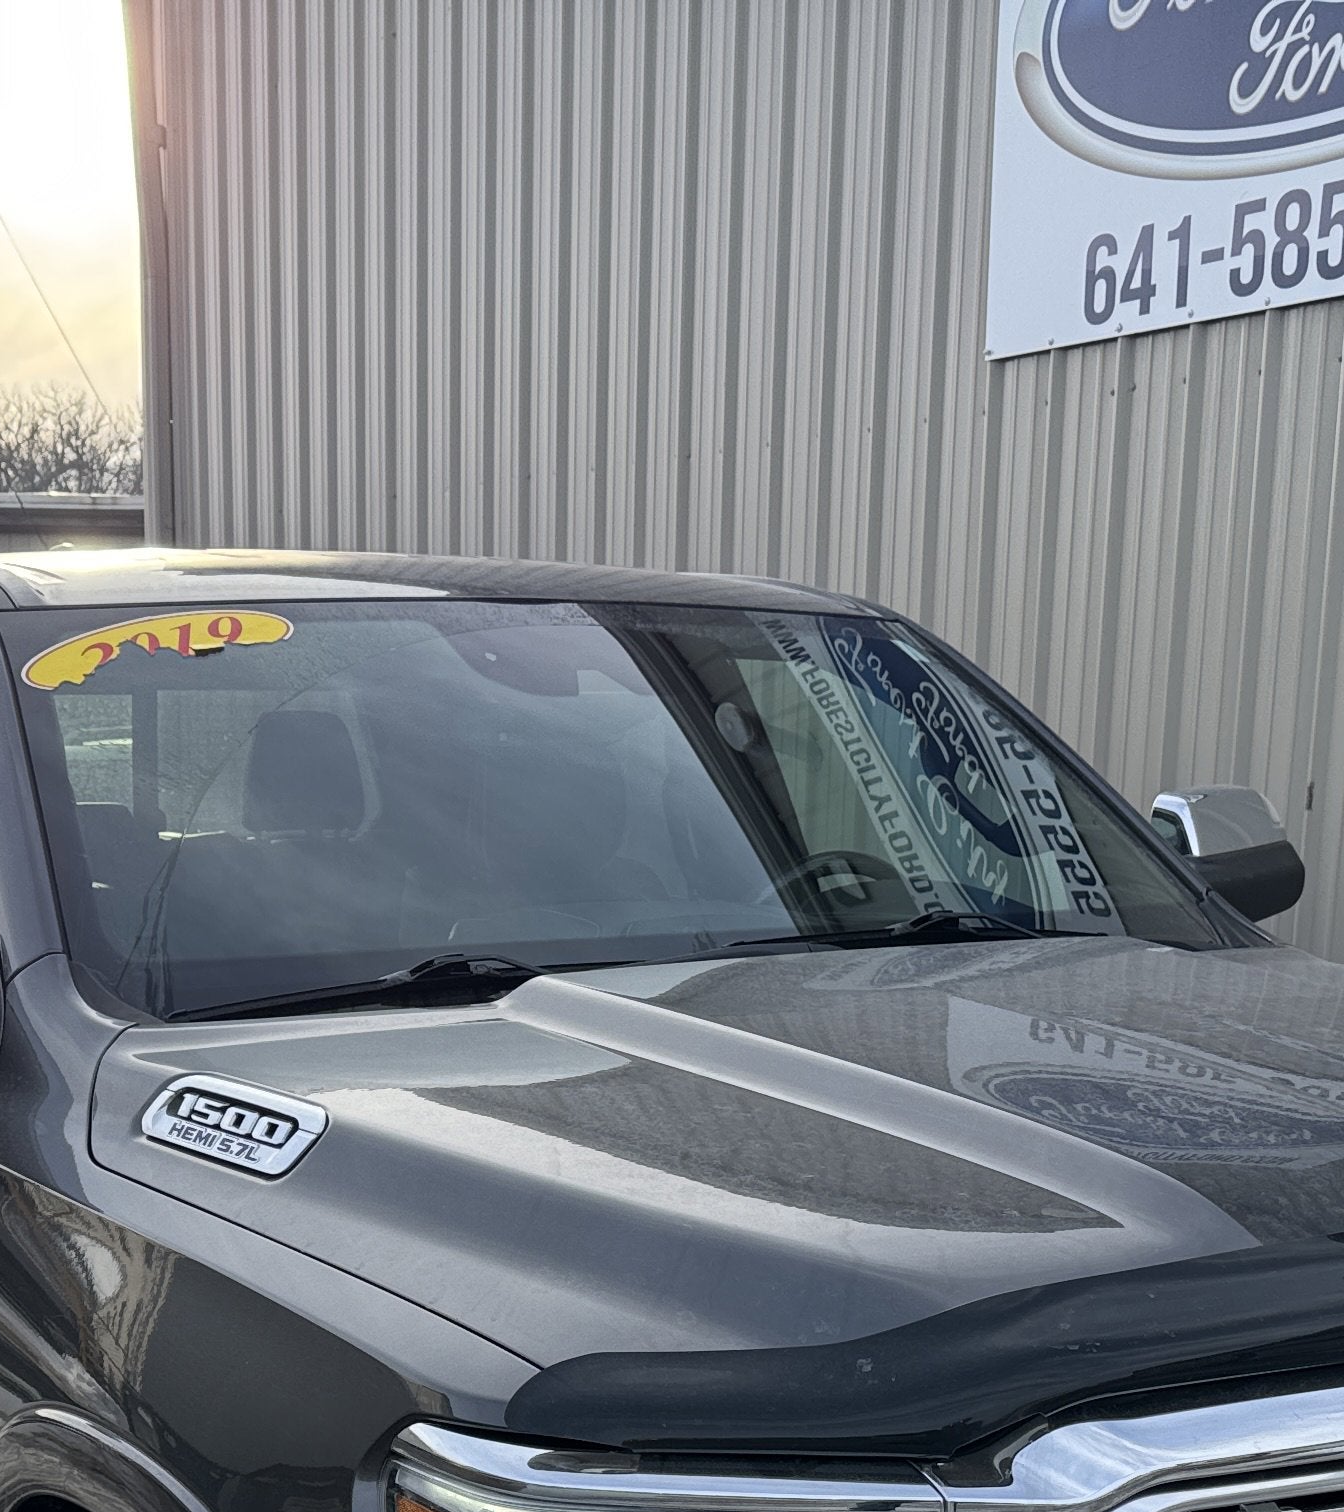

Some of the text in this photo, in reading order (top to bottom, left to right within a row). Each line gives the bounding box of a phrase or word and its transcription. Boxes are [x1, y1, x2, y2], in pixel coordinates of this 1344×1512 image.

[168, 1121, 259, 1162] HEMI 5.7L
[176, 1092, 294, 1145] 1500
